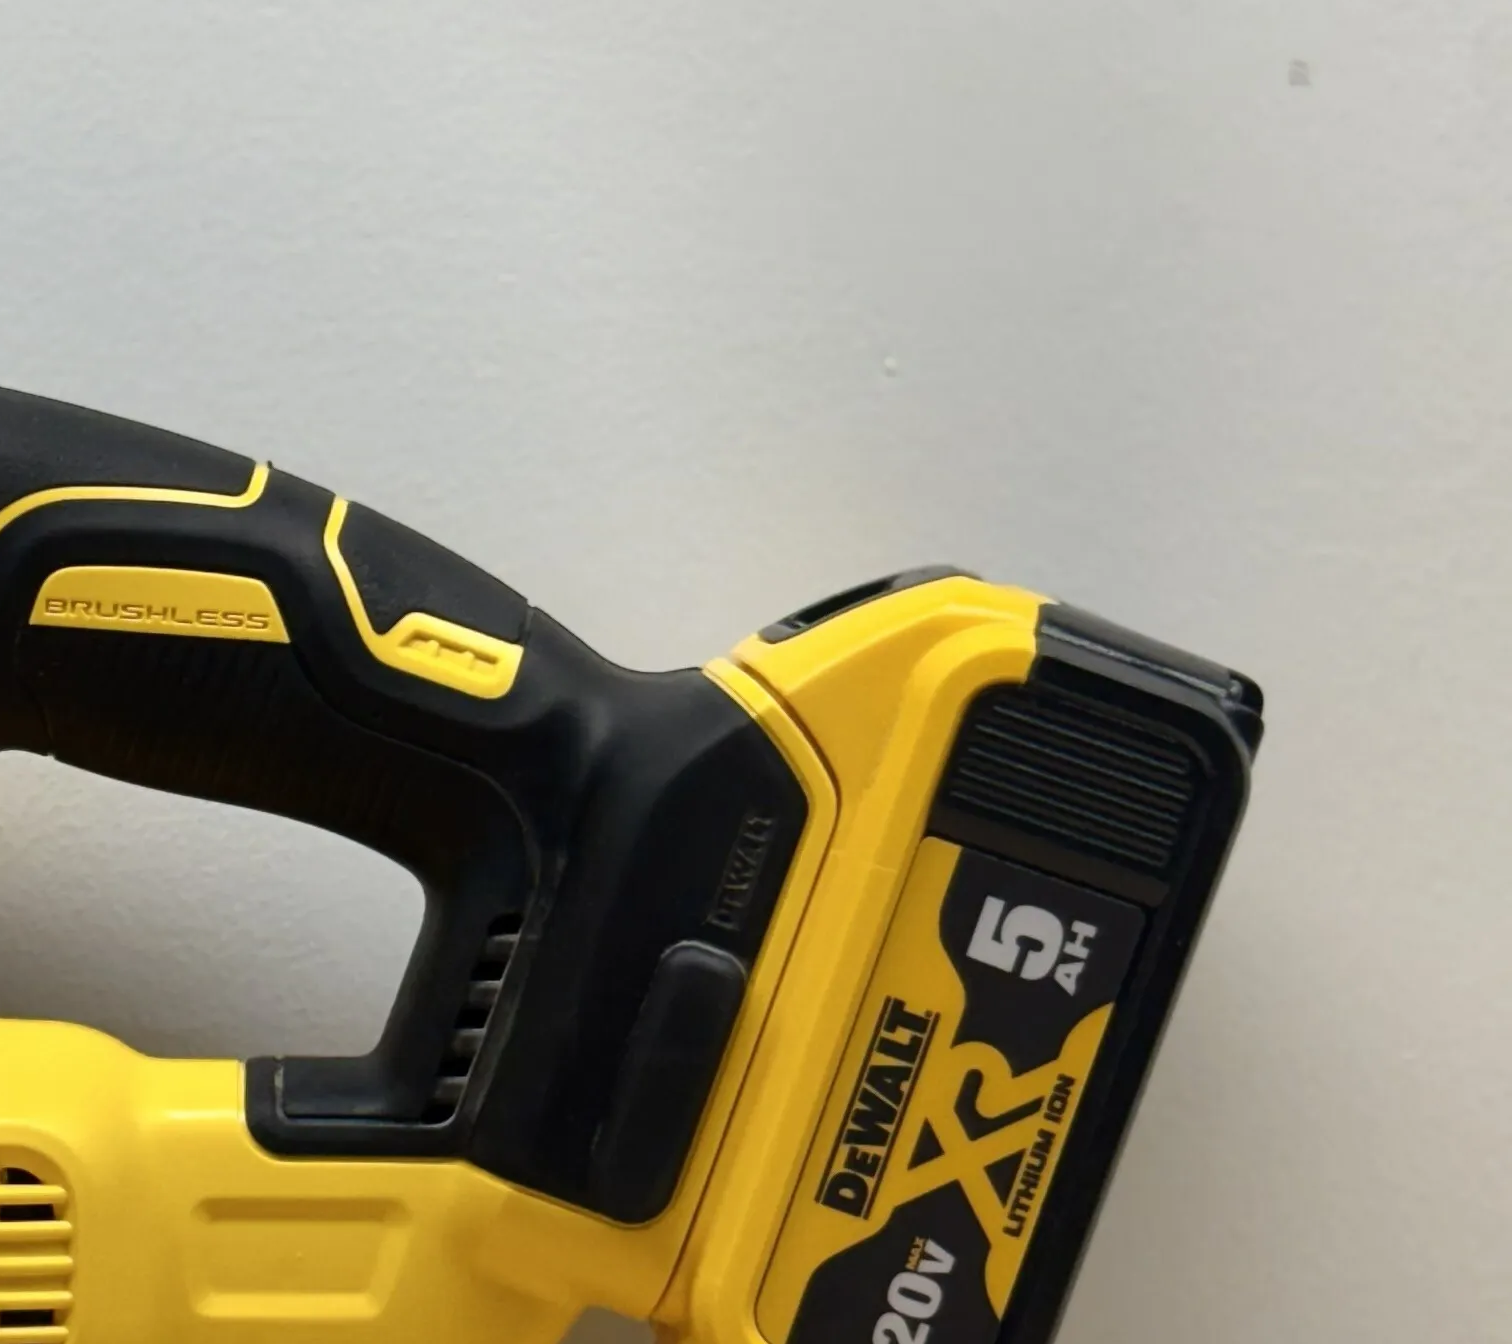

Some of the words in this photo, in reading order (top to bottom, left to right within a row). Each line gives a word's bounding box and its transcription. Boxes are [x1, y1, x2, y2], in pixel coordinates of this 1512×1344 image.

[44, 597, 270, 631] BRUSHLESS
[965, 894, 1064, 981] 5
[1002, 1127, 1057, 1238] LITHIUM
[1043, 1072, 1077, 1124] ION
